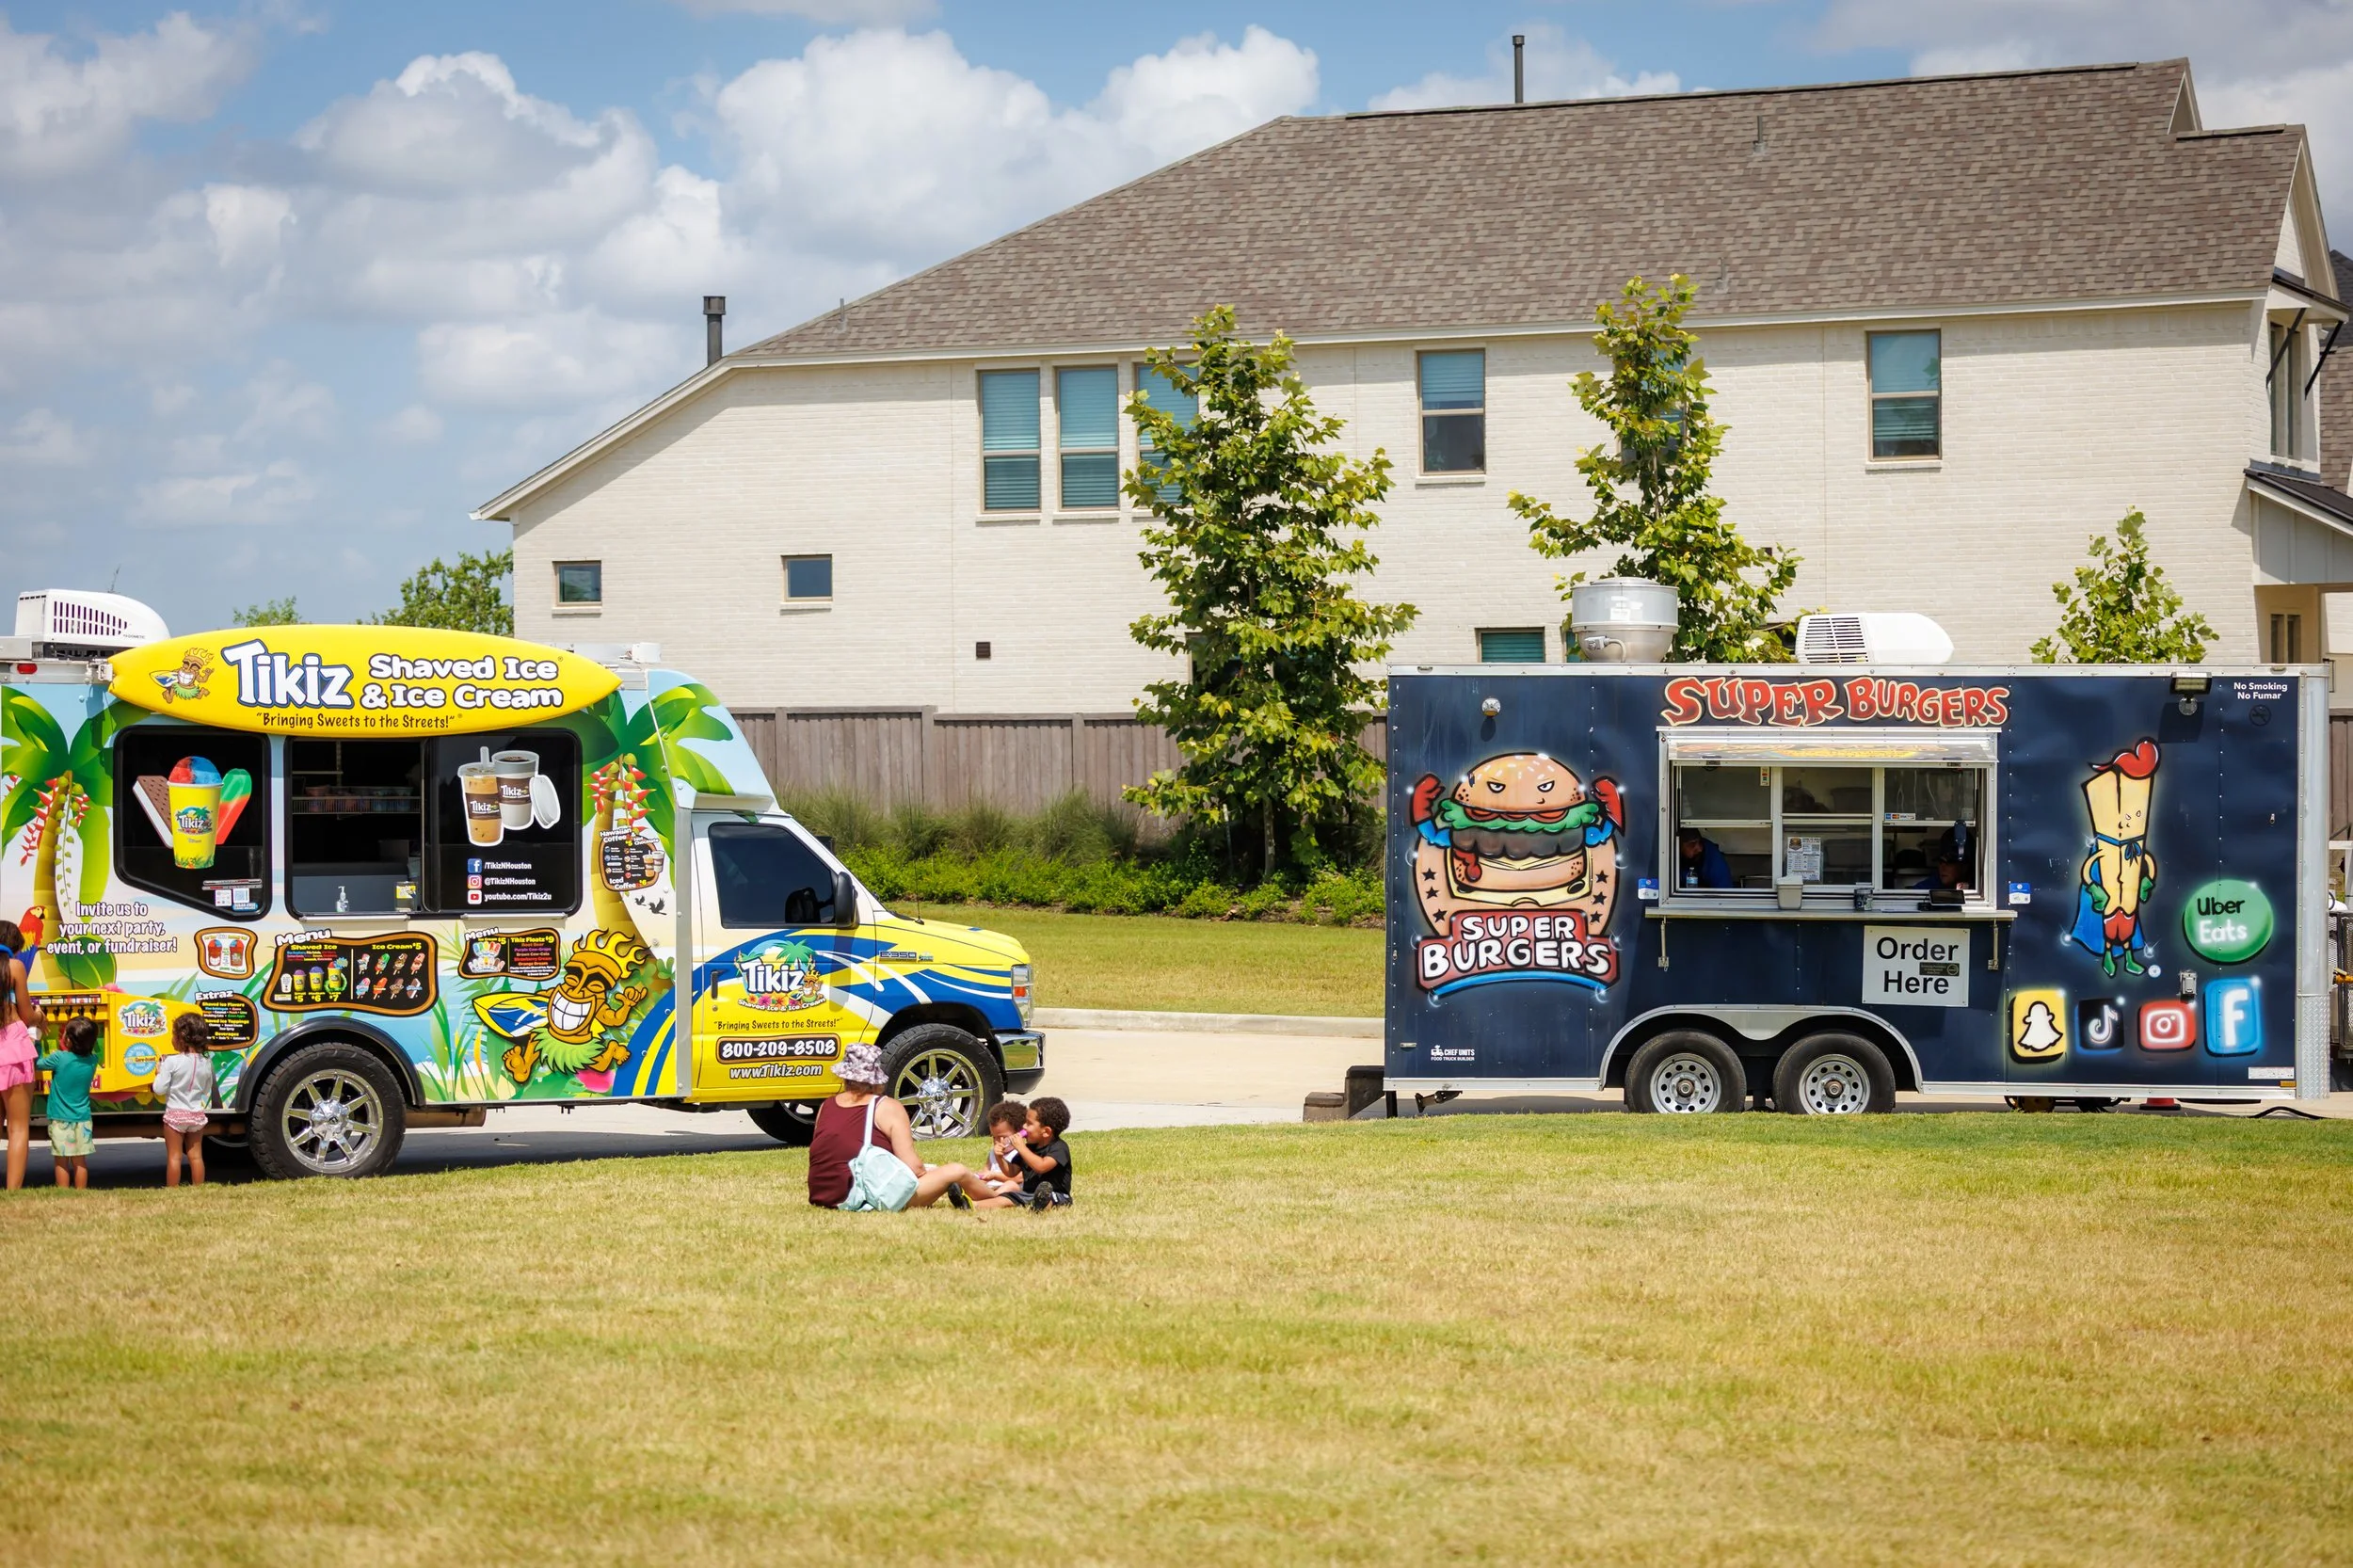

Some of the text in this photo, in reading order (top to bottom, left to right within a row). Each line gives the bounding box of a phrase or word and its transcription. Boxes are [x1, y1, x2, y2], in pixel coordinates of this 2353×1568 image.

[221, 639, 355, 709] Tikiz
[369, 653, 558, 680] Shaved Ice
[2249, 682, 2288, 692] Smoking
[360, 683, 564, 710] & Ice Cream
[1660, 676, 2010, 728] SUPER BURGERS
[317, 713, 360, 728] Sweets
[363, 715, 376, 728] to
[380, 714, 398, 728] the
[179, 815, 203, 828] Tikiz
[484, 893, 552, 902] youtube.com/Tikiz2u
[2197, 897, 2245, 916] Uber
[75, 901, 148, 917] Invite us to
[58, 920, 166, 937] your next party,
[465, 927, 499, 941] Menu
[1461, 915, 1577, 941] SUPER
[2199, 919, 2248, 943] Eats
[46, 936, 178, 955] event, or fundraiser!
[275, 929, 331, 947] Menu
[1877, 936, 1960, 961] Order
[1421, 938, 1612, 980] BURGERS
[741, 957, 806, 993] Tikiz
[1883, 970, 1949, 994] Here
[195, 990, 233, 1000] Extraz
[738, 999, 765, 1010] Shaved
[802, 998, 826, 1009] Cream
[123, 1011, 156, 1028] Tikiz
[752, 1020, 779, 1030] Sweets
[781, 1020, 789, 1029] to
[792, 1019, 804, 1028] the
[722, 1039, 836, 1058] 800-209-8508
[729, 1064, 823, 1079] www.Tikiz.com
